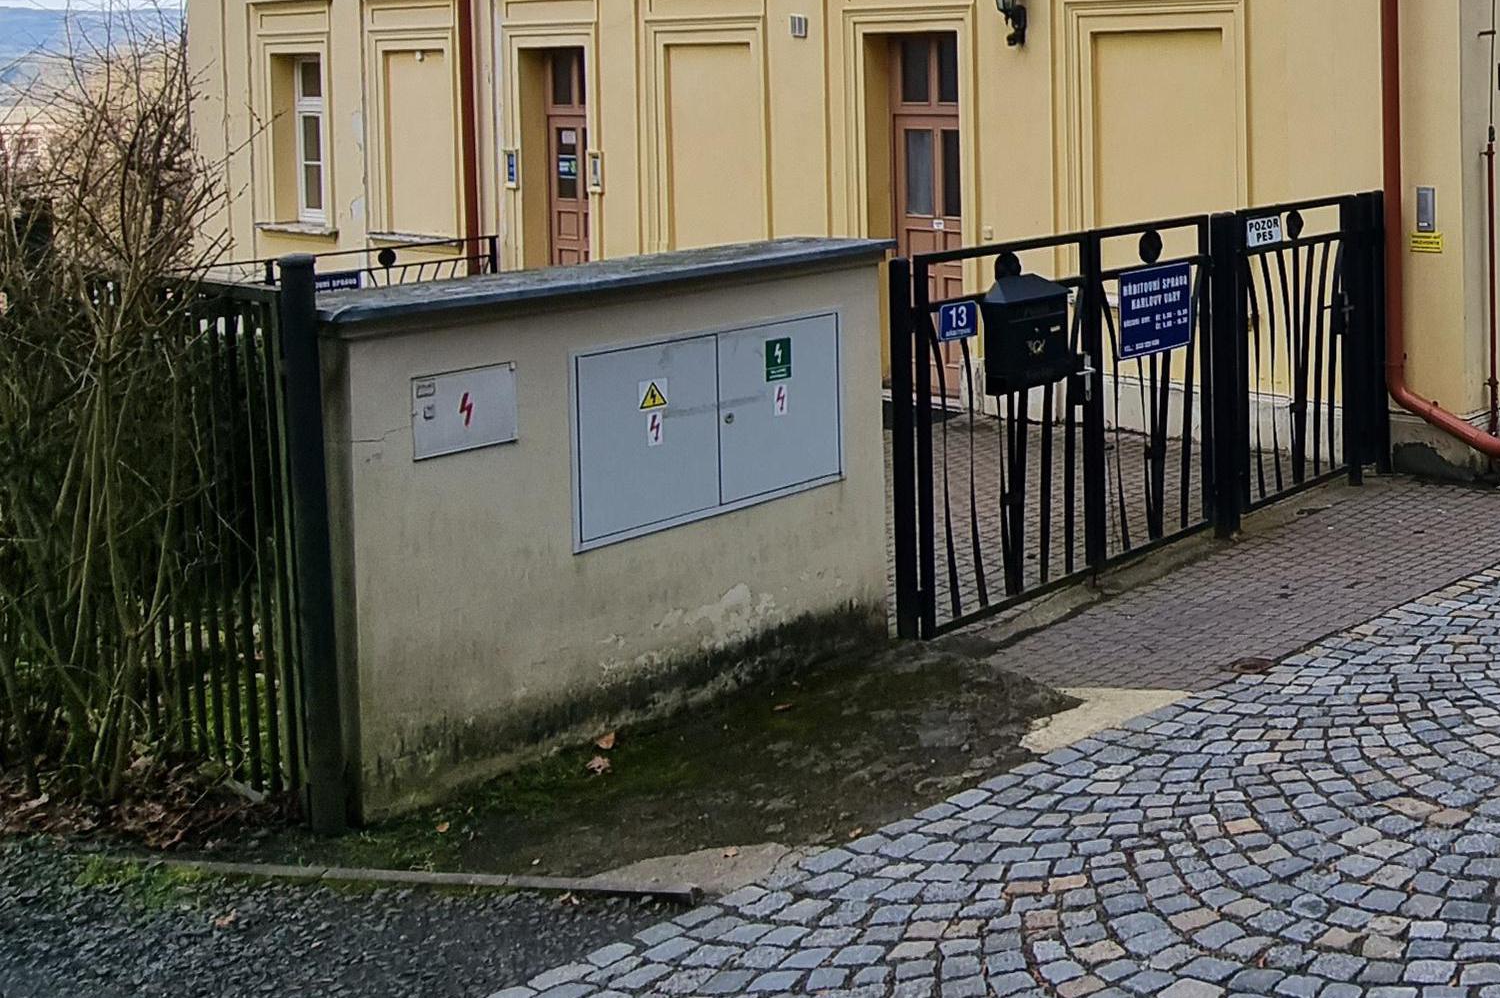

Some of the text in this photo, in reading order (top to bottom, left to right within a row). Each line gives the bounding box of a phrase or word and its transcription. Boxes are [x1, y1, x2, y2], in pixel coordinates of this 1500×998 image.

[1248, 217, 1279, 233] POZOR
[1256, 230, 1274, 243] PES
[1131, 290, 1181, 311] KARLOVY VARY
[949, 305, 967, 328] 13
